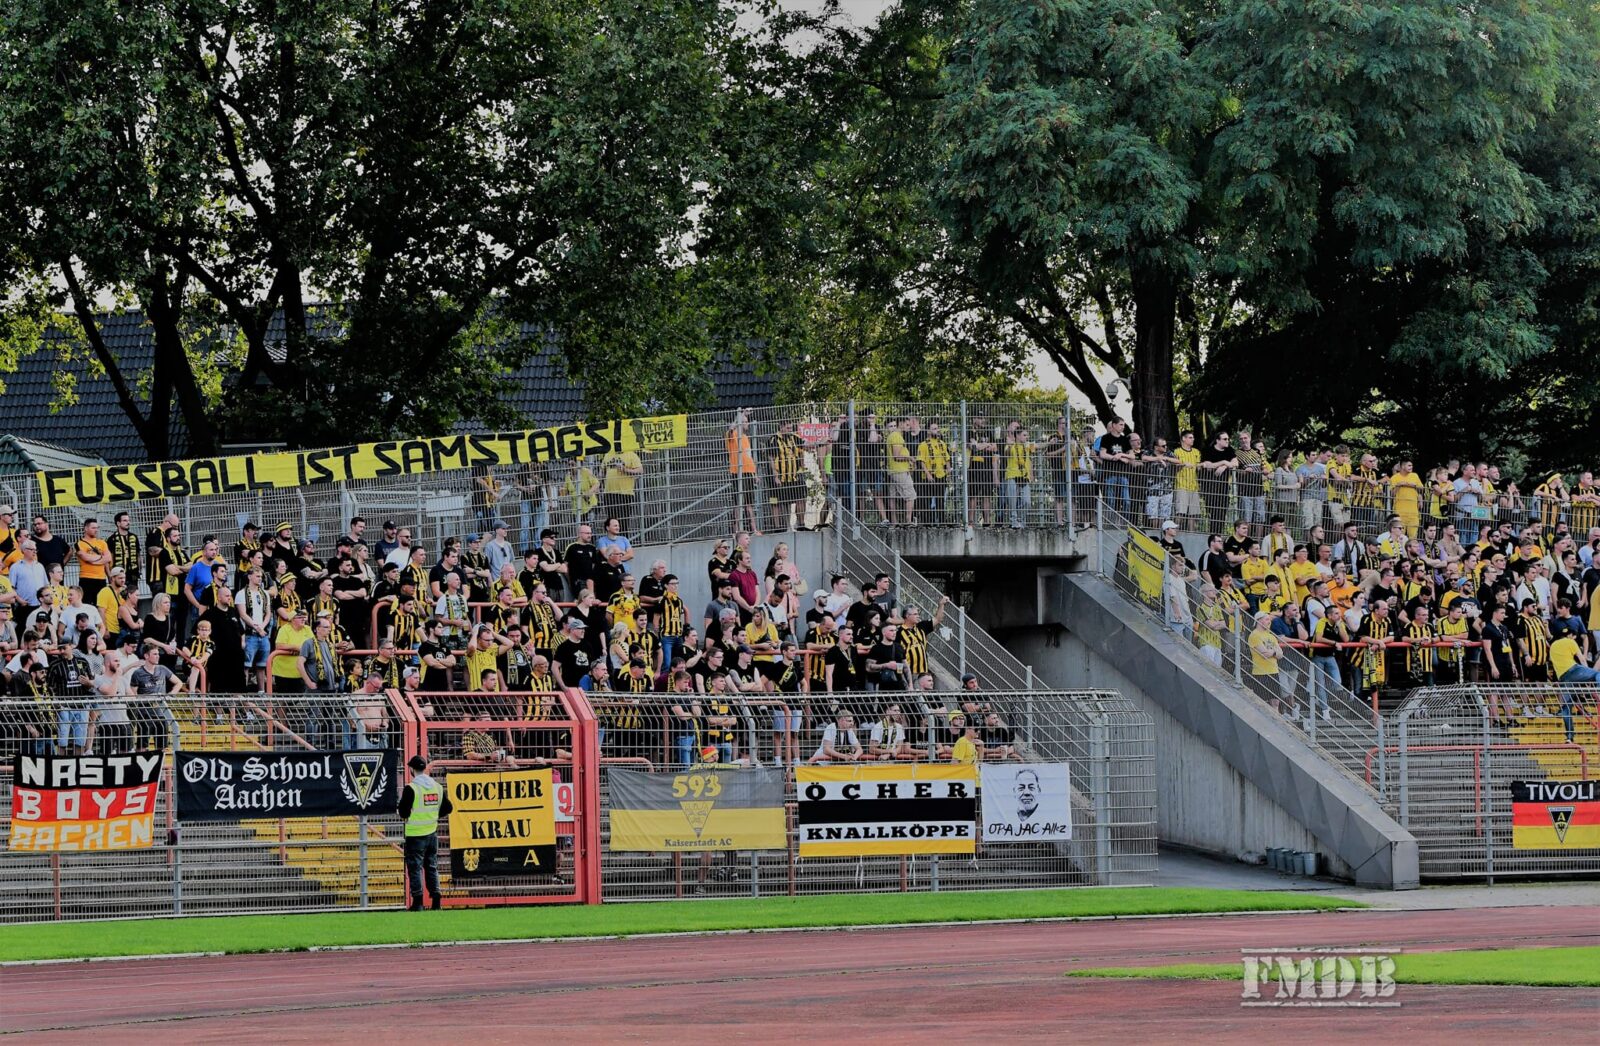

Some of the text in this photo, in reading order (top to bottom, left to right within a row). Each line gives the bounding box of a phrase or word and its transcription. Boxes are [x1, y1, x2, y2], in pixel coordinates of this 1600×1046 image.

[44, 421, 622, 505] FUSSBALL IST SAMSTAGS!
[21, 755, 160, 787] NASTY
[182, 755, 334, 785] Old School
[359, 763, 370, 776] A
[455, 779, 543, 801] OECHER
[671, 774, 722, 798] 593
[805, 782, 968, 800] ÖCHER
[1525, 783, 1595, 801] TIVOLI
[16, 786, 149, 820] BOYS
[214, 783, 303, 812] Aachen
[557, 785, 573, 814] 9
[10, 816, 151, 850] AACHEN
[470, 819, 532, 840] KRAU
[806, 823, 969, 840] KNALLKÖPPE
[988, 823, 1013, 836] OPA
[1014, 822, 1040, 836] JAC
[664, 838, 732, 848] Kaiserstadt AC
[523, 849, 541, 867] A
